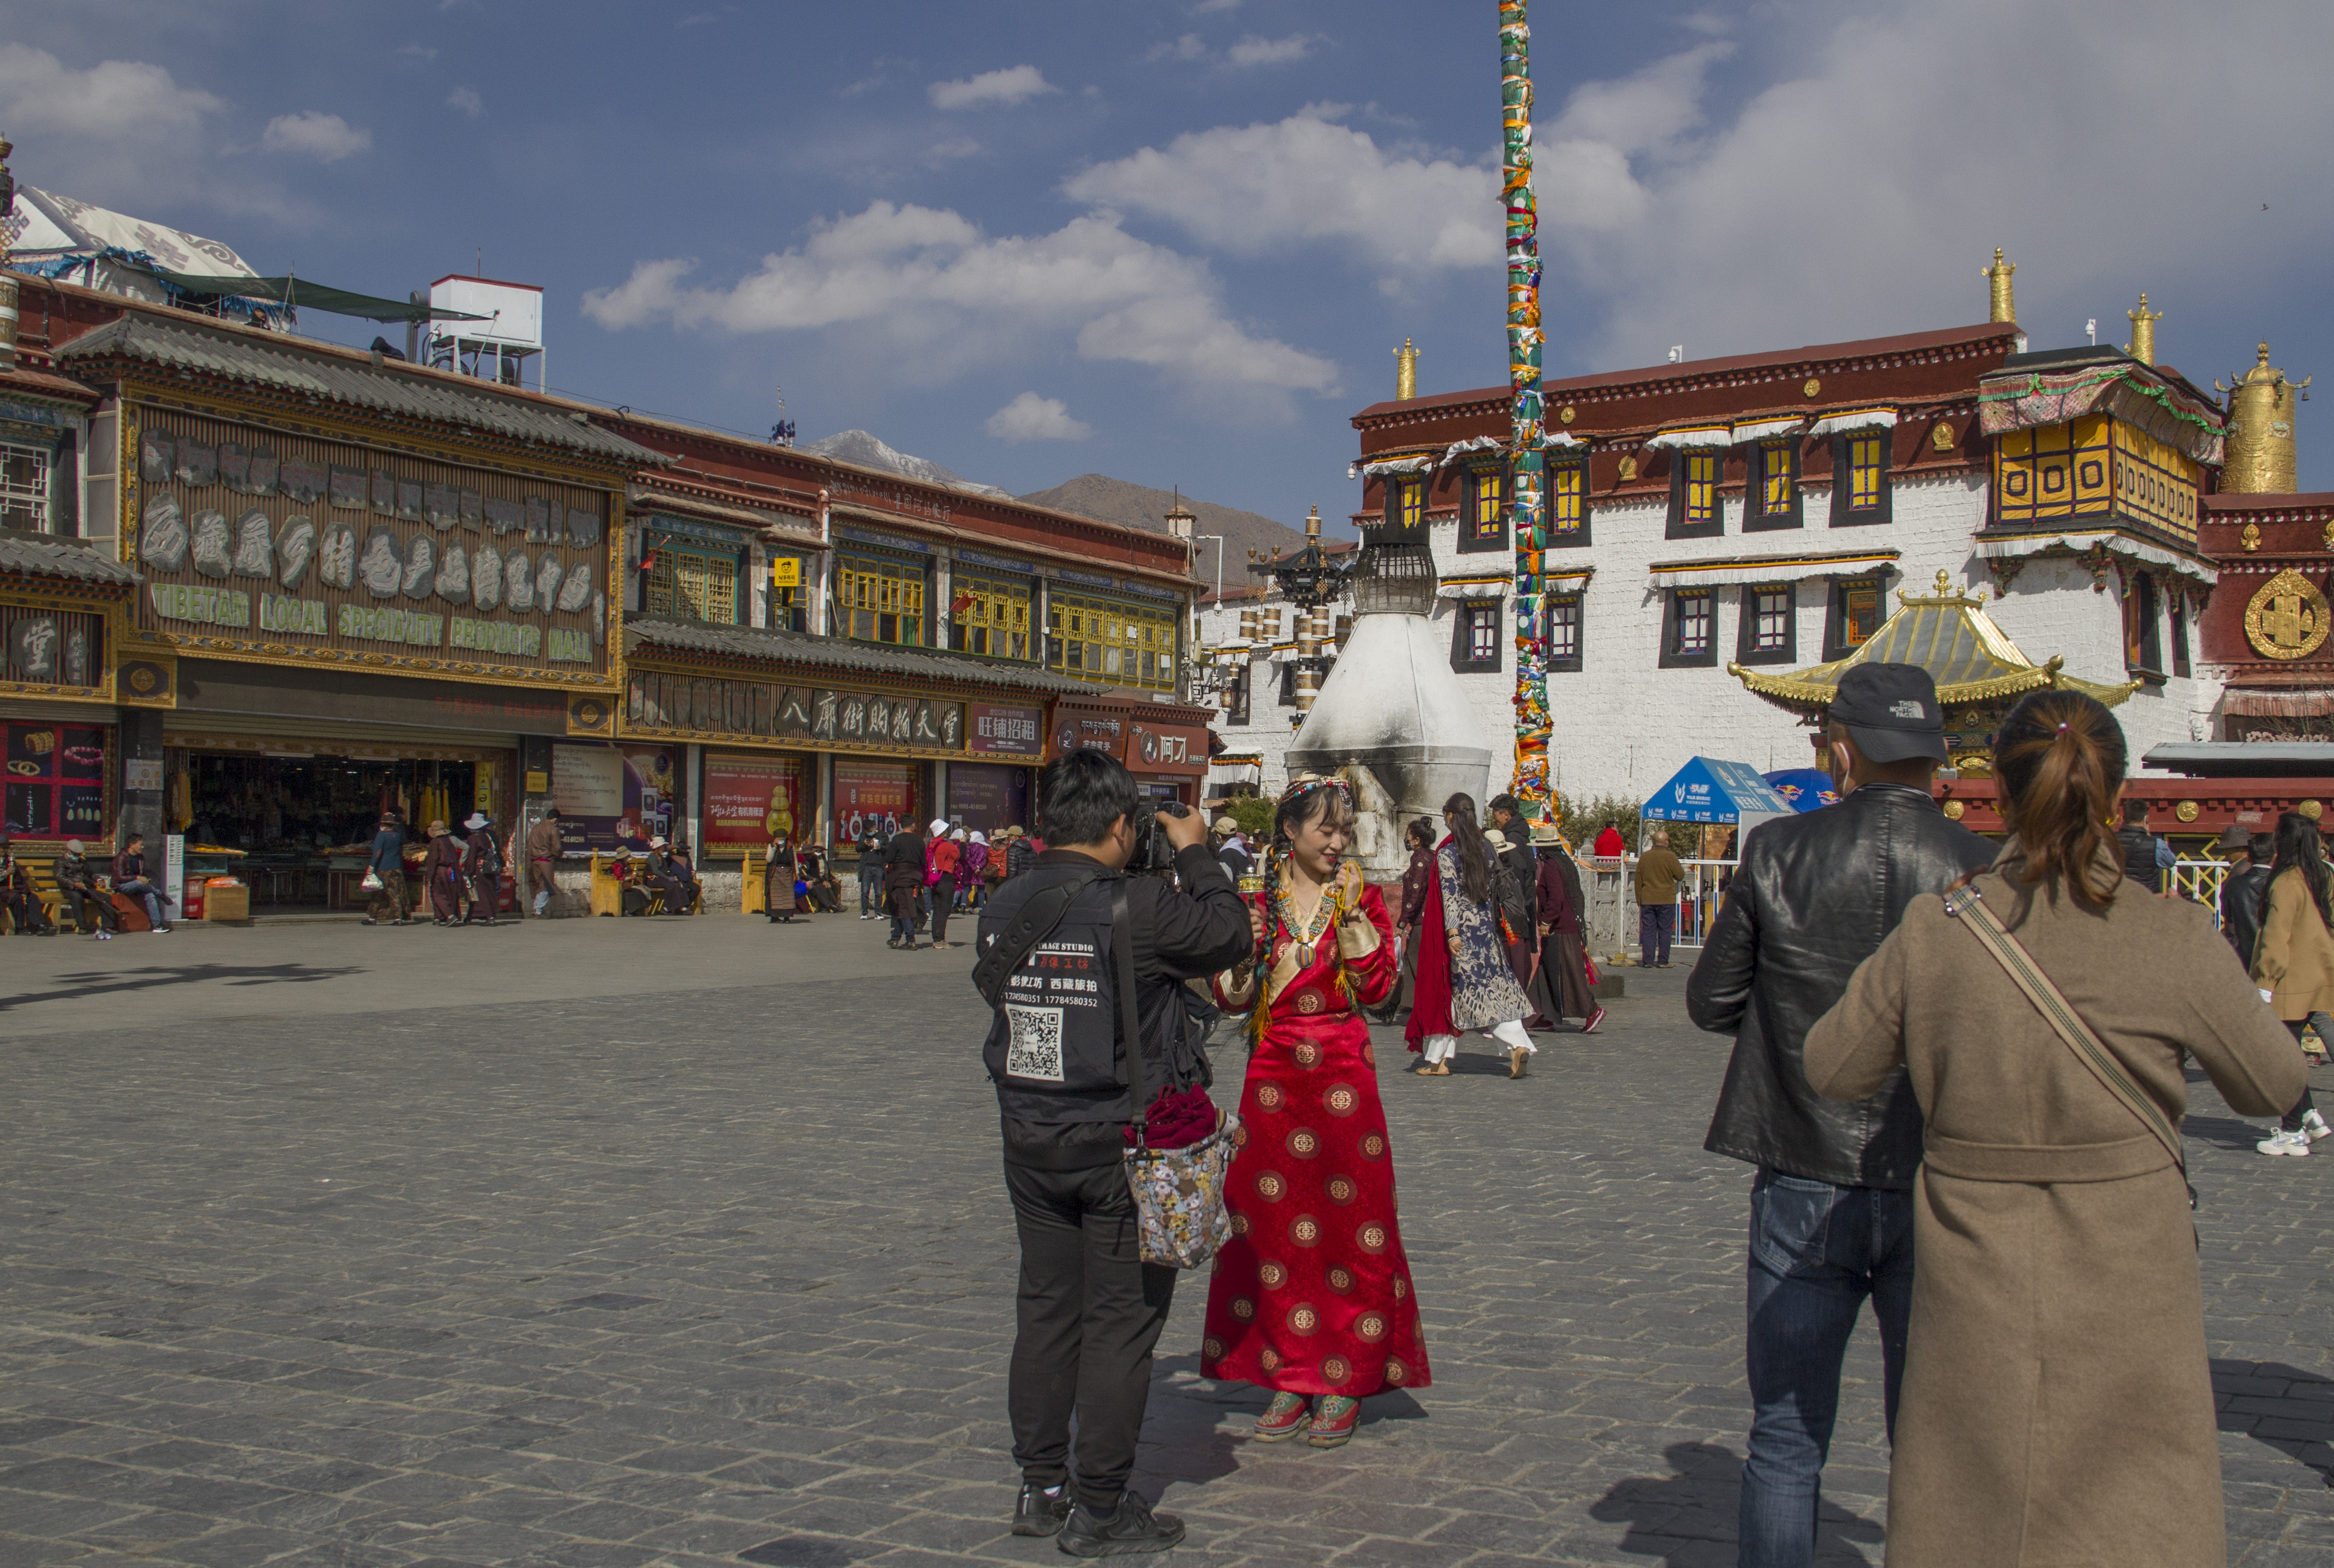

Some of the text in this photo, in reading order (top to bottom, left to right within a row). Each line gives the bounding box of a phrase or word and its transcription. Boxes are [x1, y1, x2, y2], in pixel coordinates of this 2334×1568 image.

[154, 584, 591, 662] TIBETAN LOCAL SPECIALITY PRODUCTS MALL
[23, 619, 56, 671] 堂
[978, 716, 1035, 741] 旺铺招租
[1158, 735, 1187, 764] 阿刁
[1038, 942, 1094, 952] IMAGE STUDIO
[1039, 955, 1089, 970] 影像工坊
[1010, 975, 1097, 993] 影像工坊 西藏旅拍
[1044, 995, 1098, 1007] 17784580352
